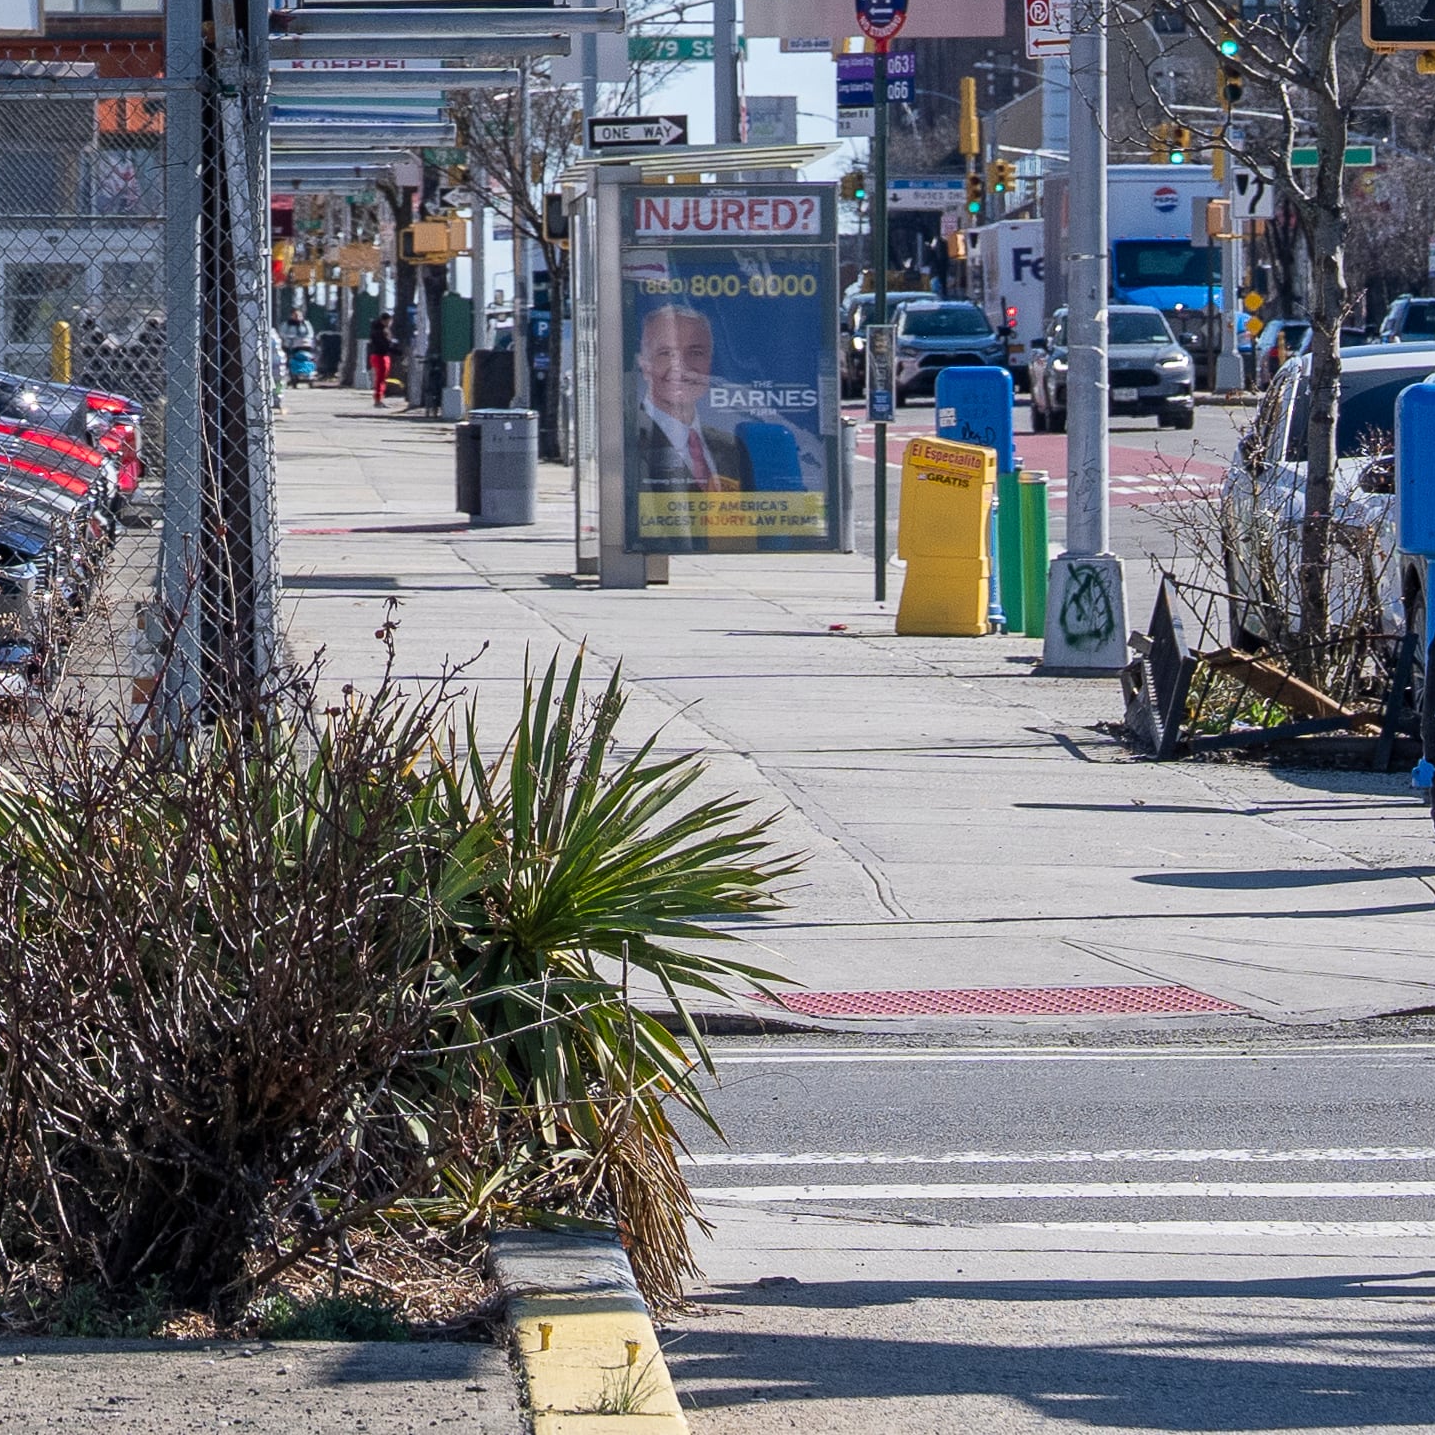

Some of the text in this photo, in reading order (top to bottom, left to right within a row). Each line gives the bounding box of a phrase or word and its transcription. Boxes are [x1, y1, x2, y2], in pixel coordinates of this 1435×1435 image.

[653, 41, 714, 60] 79 St
[887, 55, 909, 74] Q63
[887, 81, 909, 100] Q66
[601, 125, 673, 140] ONE WAY
[634, 197, 815, 231] INJURED?
[691, 274, 818, 297] 800-0000
[752, 380, 773, 389] THE
[709, 387, 818, 408] BARNES
[912, 443, 982, 469] El Especialito
[927, 472, 970, 488] GRATIS
[667, 500, 788, 512] ONE OF AMERICA'S
[640, 515, 696, 527] LARGEST
[699, 515, 745, 527] INJURY
[748, 515, 776, 527] LAW
